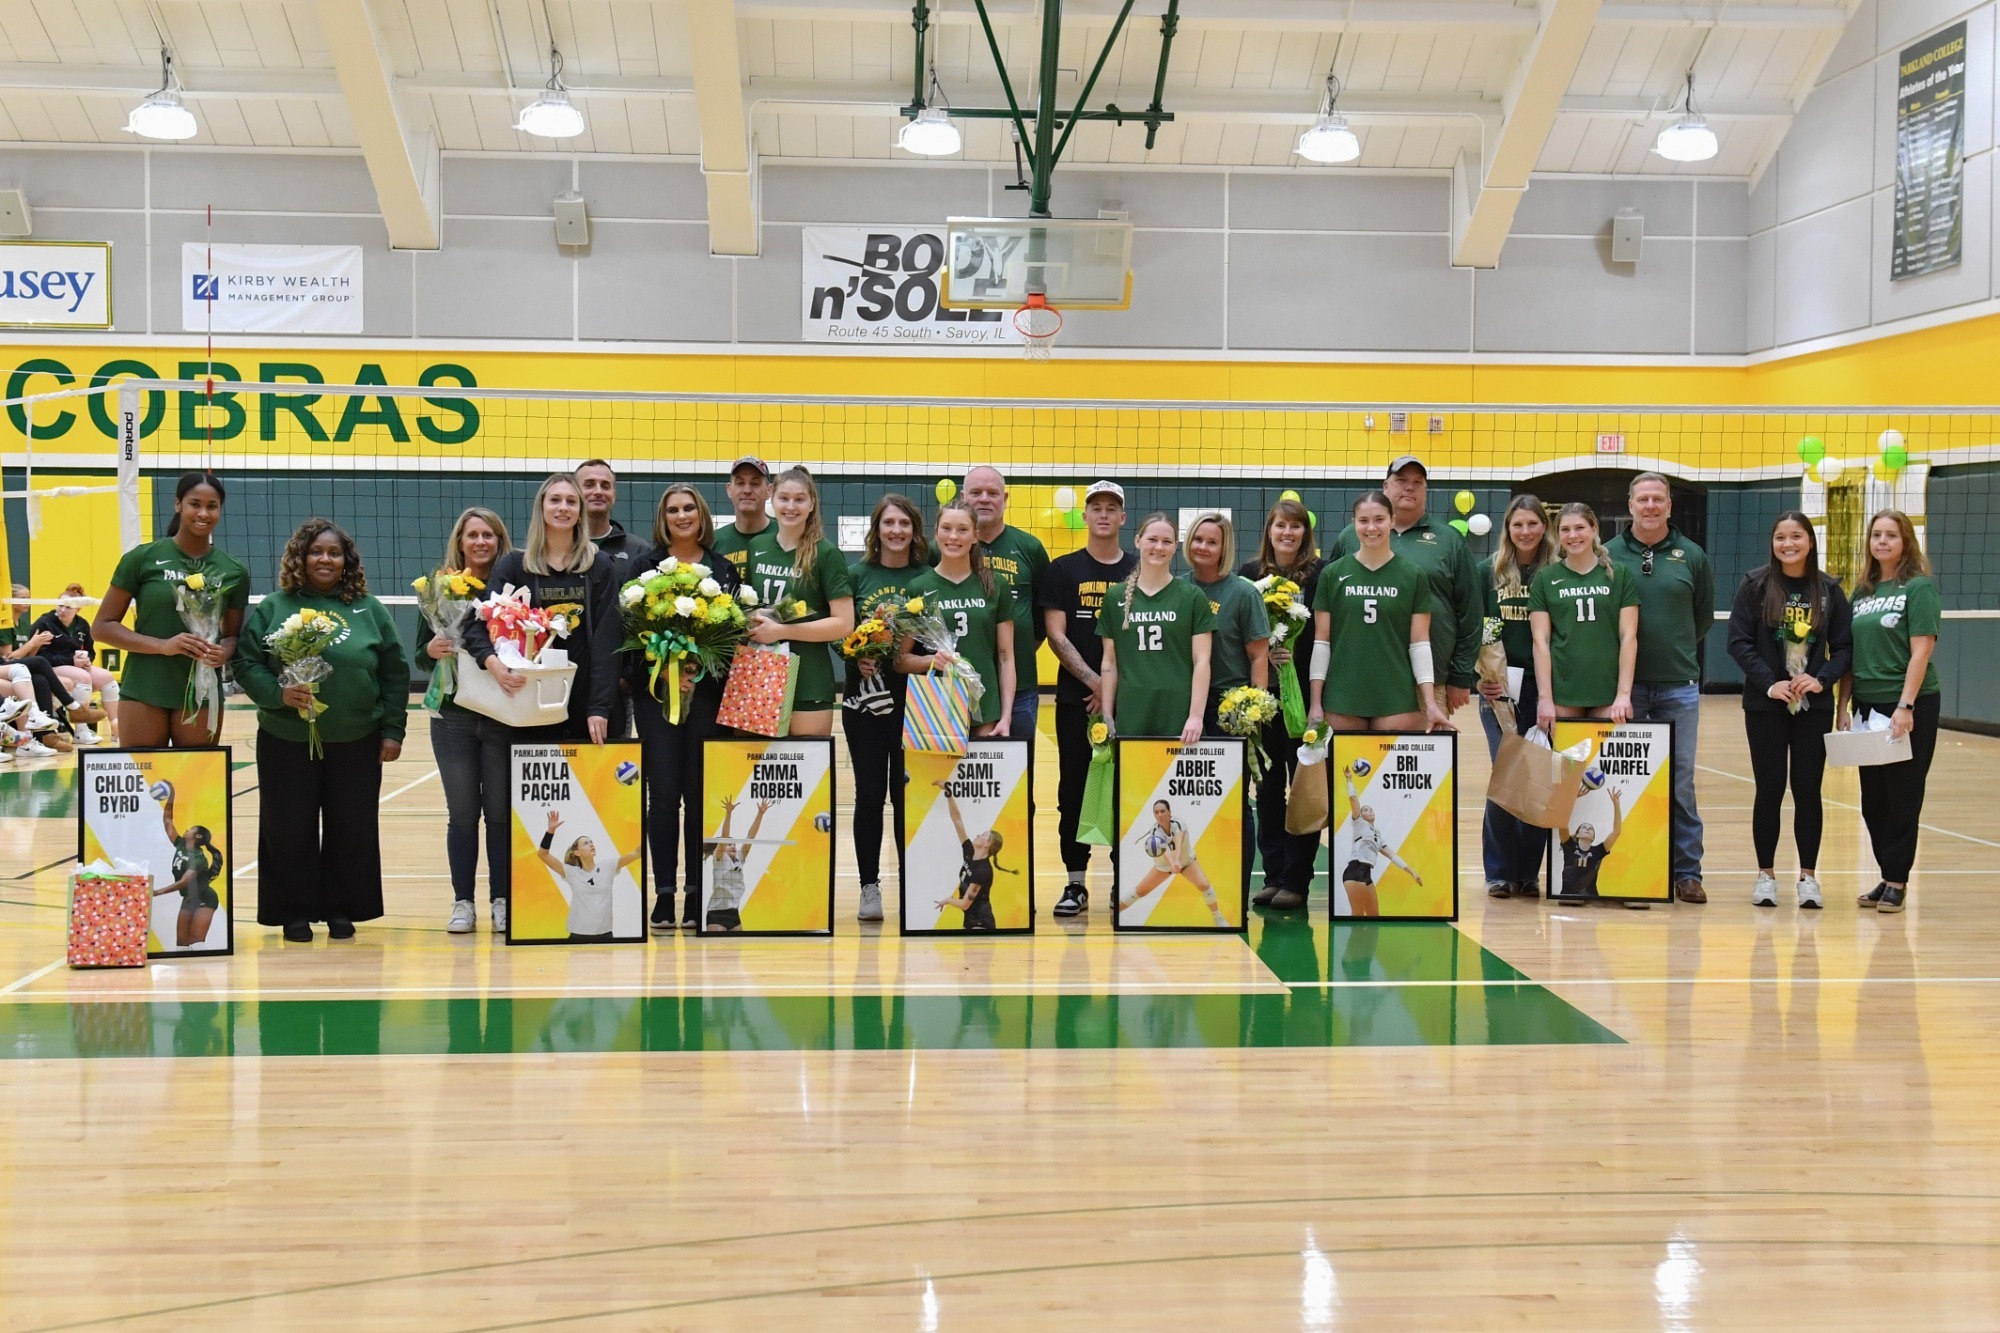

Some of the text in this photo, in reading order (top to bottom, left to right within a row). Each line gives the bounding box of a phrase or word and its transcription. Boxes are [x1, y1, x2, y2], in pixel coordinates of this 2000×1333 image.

[228, 275, 350, 287] KIRBY WEALTH
[228, 293, 306, 302] MANAGEMENT
[827, 325, 1006, 341] Route 45 South Savoy, IL
[6, 358, 481, 444] COBRAS
[1601, 435, 1621, 450] EXIT
[756, 563, 803, 578] PARKLAND
[992, 557, 1019, 575] COLLEGE
[763, 579, 787, 605] 17
[1078, 581, 1107, 596] PARKLAND
[1345, 586, 1398, 598] PARKLAND
[1559, 586, 1610, 598] PARKLAND
[938, 598, 986, 610] ARKLAND
[1081, 595, 1104, 607] VOLLE
[1576, 597, 1596, 621] 11
[1128, 610, 1177, 623] ARKLAND
[1363, 599, 1378, 624] 5
[954, 611, 968, 637] 3
[1137, 624, 1163, 651] 12
[514, 749, 577, 757] PARKLAND COLLEGE
[1600, 742, 1650, 758] LANDRY
[87, 762, 153, 771] PARKLAND COLLEGE
[522, 762, 569, 781] KAYLA
[957, 763, 993, 780] SAMI
[1176, 760, 1216, 777] ABBIE
[1397, 755, 1418, 772] BRI
[1600, 760, 1650, 775] WARFEL
[753, 764, 798, 781] EMMA
[1383, 773, 1432, 789] STRUCK
[95, 775, 144, 794] CHLOE
[521, 783, 570, 801] PACHA
[751, 782, 802, 799] ROBBEN
[944, 781, 1001, 798] SCHULTE
[1168, 779, 1222, 796] SKAGGS
[100, 795, 139, 813] BYRD
